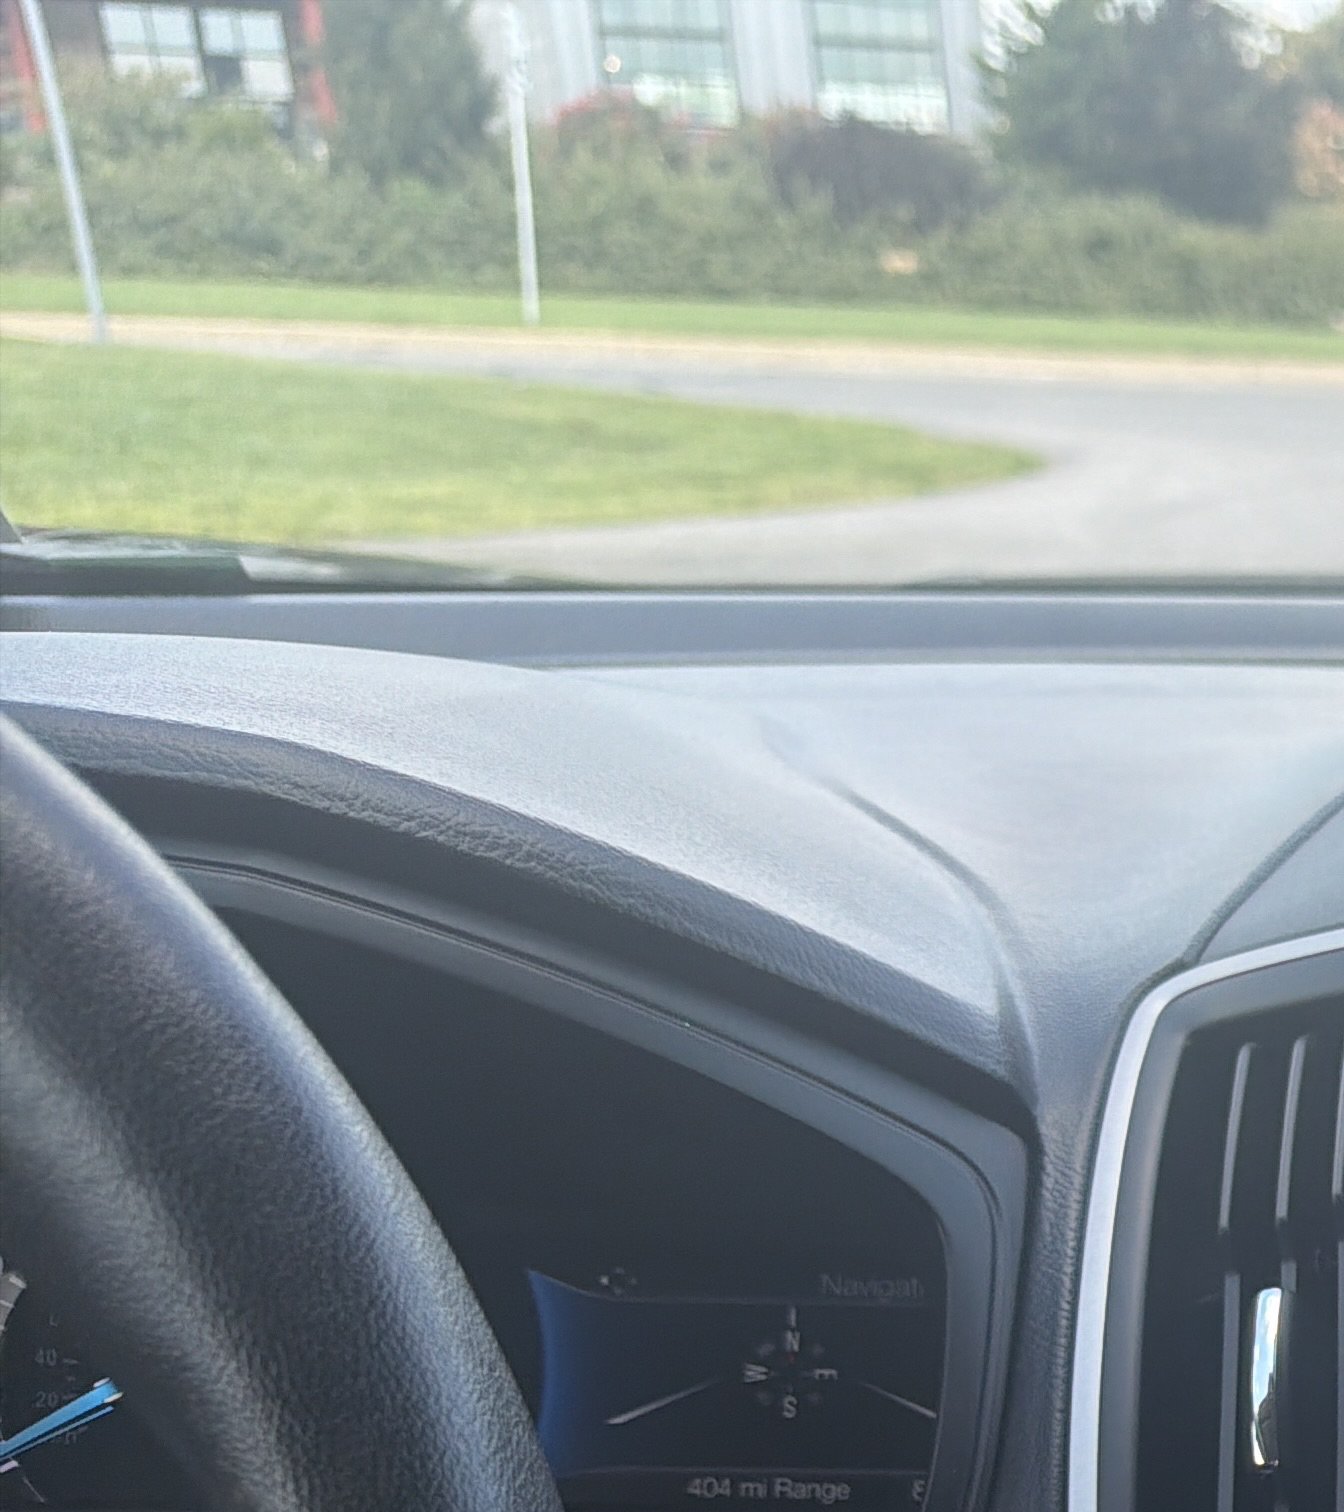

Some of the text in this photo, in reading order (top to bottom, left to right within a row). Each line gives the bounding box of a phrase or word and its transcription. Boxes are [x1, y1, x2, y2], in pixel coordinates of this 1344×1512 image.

[686, 1477, 852, 1505] 404 mi Range
